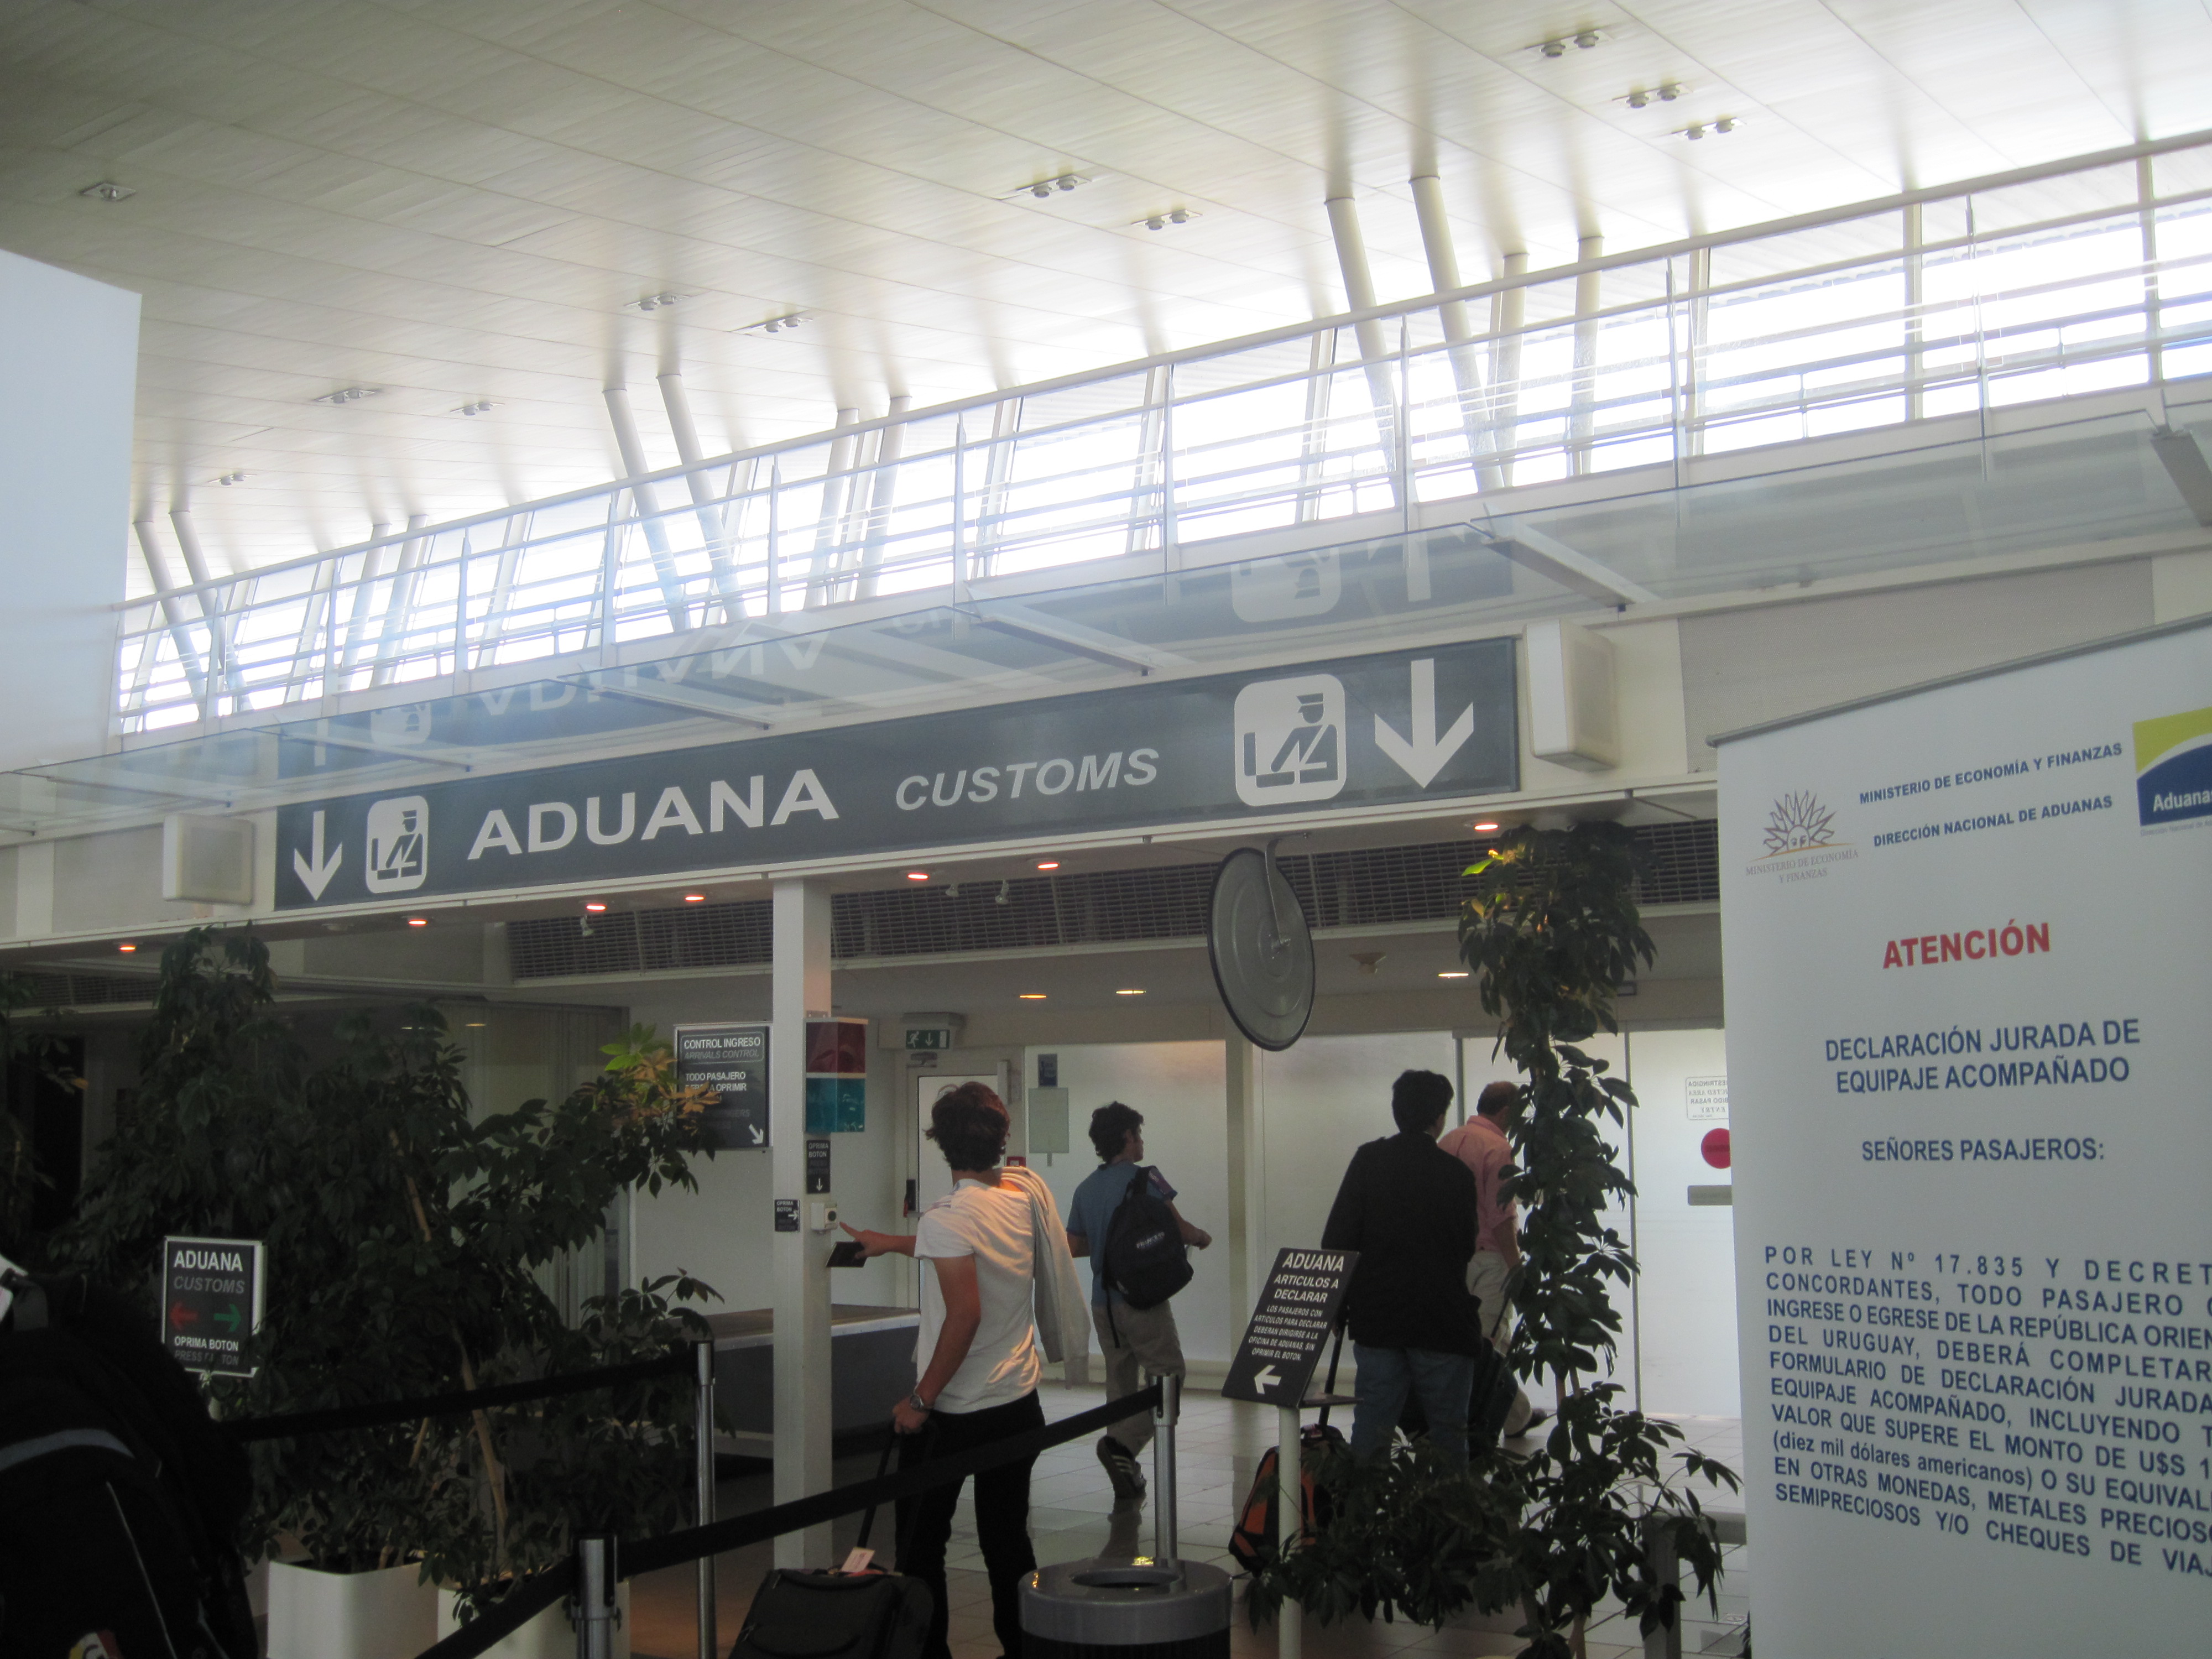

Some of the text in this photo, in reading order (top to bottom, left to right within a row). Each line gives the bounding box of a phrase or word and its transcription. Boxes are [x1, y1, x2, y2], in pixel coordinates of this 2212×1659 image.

[1860, 742, 2122, 804] MINISTERIO DE ECONOMÍA Y FINANZAS
[467, 748, 1159, 860] ADUANA CUSTOMS
[2153, 790, 2212, 813] Aduana
[1874, 795, 2112, 847] DIRECCIÓN NACIONAL DE ADUANAS
[1746, 848, 1858, 876] MINISTERIO DE ECONOMÍA
[1779, 867, 1827, 883] Y FINANZAS
[1883, 919, 2049, 969] ATENCIÓN
[684, 1037, 761, 1049] CONTROL INGRESO
[1826, 1018, 2140, 1061] DECLARACIÓN JURADA DE
[684, 1048, 759, 1060] ARRIVALS CONTROL
[686, 1072, 746, 1082] TODO PASAJERO
[1837, 1055, 2130, 1094] EQUIPAJE ACOMPAÑADO
[716, 1083, 747, 1092] OPRIMIR
[1862, 1136, 2104, 1161] SEÑORES PASAJEROS:
[174, 1250, 243, 1272] ADUANA
[1282, 1252, 1344, 1272] ADUANA
[1765, 1246, 1813, 1265] POR
[1831, 1249, 1873, 1268] LEY
[1935, 1254, 2022, 1277] 17.835
[2046, 1258, 2060, 1279] Y
[173, 1276, 245, 1294] CUSTOMS
[1274, 1274, 1339, 1289] ARTICULOS A
[1274, 1288, 1328, 1303] DECLARAR
[1766, 1272, 1940, 1305] CONCORDANTES,
[1957, 1283, 2022, 1307] TODO
[2042, 1287, 2183, 1316] PASAJERO
[1254, 1314, 1328, 1329] ARTICULOS PARA DECLARAR
[1266, 1305, 1278, 1313] LOS
[1278, 1306, 1310, 1316] PASAJEROS
[1767, 1298, 1844, 1321] INGRESE
[1849, 1305, 1862, 1323] O
[1867, 1306, 1939, 1330] EGRESE
[1945, 1312, 1971, 1333] DE
[1978, 1314, 2004, 1335] LA
[2009, 1314, 2138, 1345] REPÚBLICA
[174, 1335, 239, 1352] OPRIMA BOTON
[1249, 1335, 1270, 1345] OFICINA
[1305, 1342, 1316, 1351] SIN
[1254, 1326, 1279, 1335] DEBERAN
[1279, 1328, 1306, 1338] DIRIGIRSE
[175, 1350, 202, 1362] PRESS
[1251, 1347, 1274, 1357] OPRIMIR
[1274, 1350, 1281, 1358] EL
[1768, 1325, 2212, 1383] DEL URUGUAY, DEBERÁ COMPLETAR
[1770, 1350, 1886, 1381] FORMULARIO
[1901, 1364, 1925, 1385] DE
[1941, 1368, 2095, 1403] DECLARACIÓN
[1771, 1377, 1856, 1405] EQUIPAJE
[1870, 1388, 2012, 1428] ACOMPAÑADO,
[2030, 1407, 2180, 1443] INCLUYENDO
[1771, 1403, 1832, 1428] VALOR
[1840, 1412, 1876, 1435] QUE
[1885, 1418, 1959, 1447] SUPERE
[1969, 1430, 1995, 1452] EL
[2005, 1433, 2083, 1463] MONTO
[2095, 1445, 2126, 1469] DE
[2139, 1450, 2185, 1477] U$S
[1773, 1430, 2212, 1512] (diez mil dólares americanos) O SU EQUIVAL
[1774, 1456, 2212, 1544] EN OTRAS MONEDAS, METALES PRECIOS
[1775, 1483, 1920, 1526] SEMIPRECIOSOS
[1936, 1510, 1969, 1535] Y/O
[1986, 1519, 2090, 1557] CHEQUES
[2110, 1540, 2142, 1566] DE
